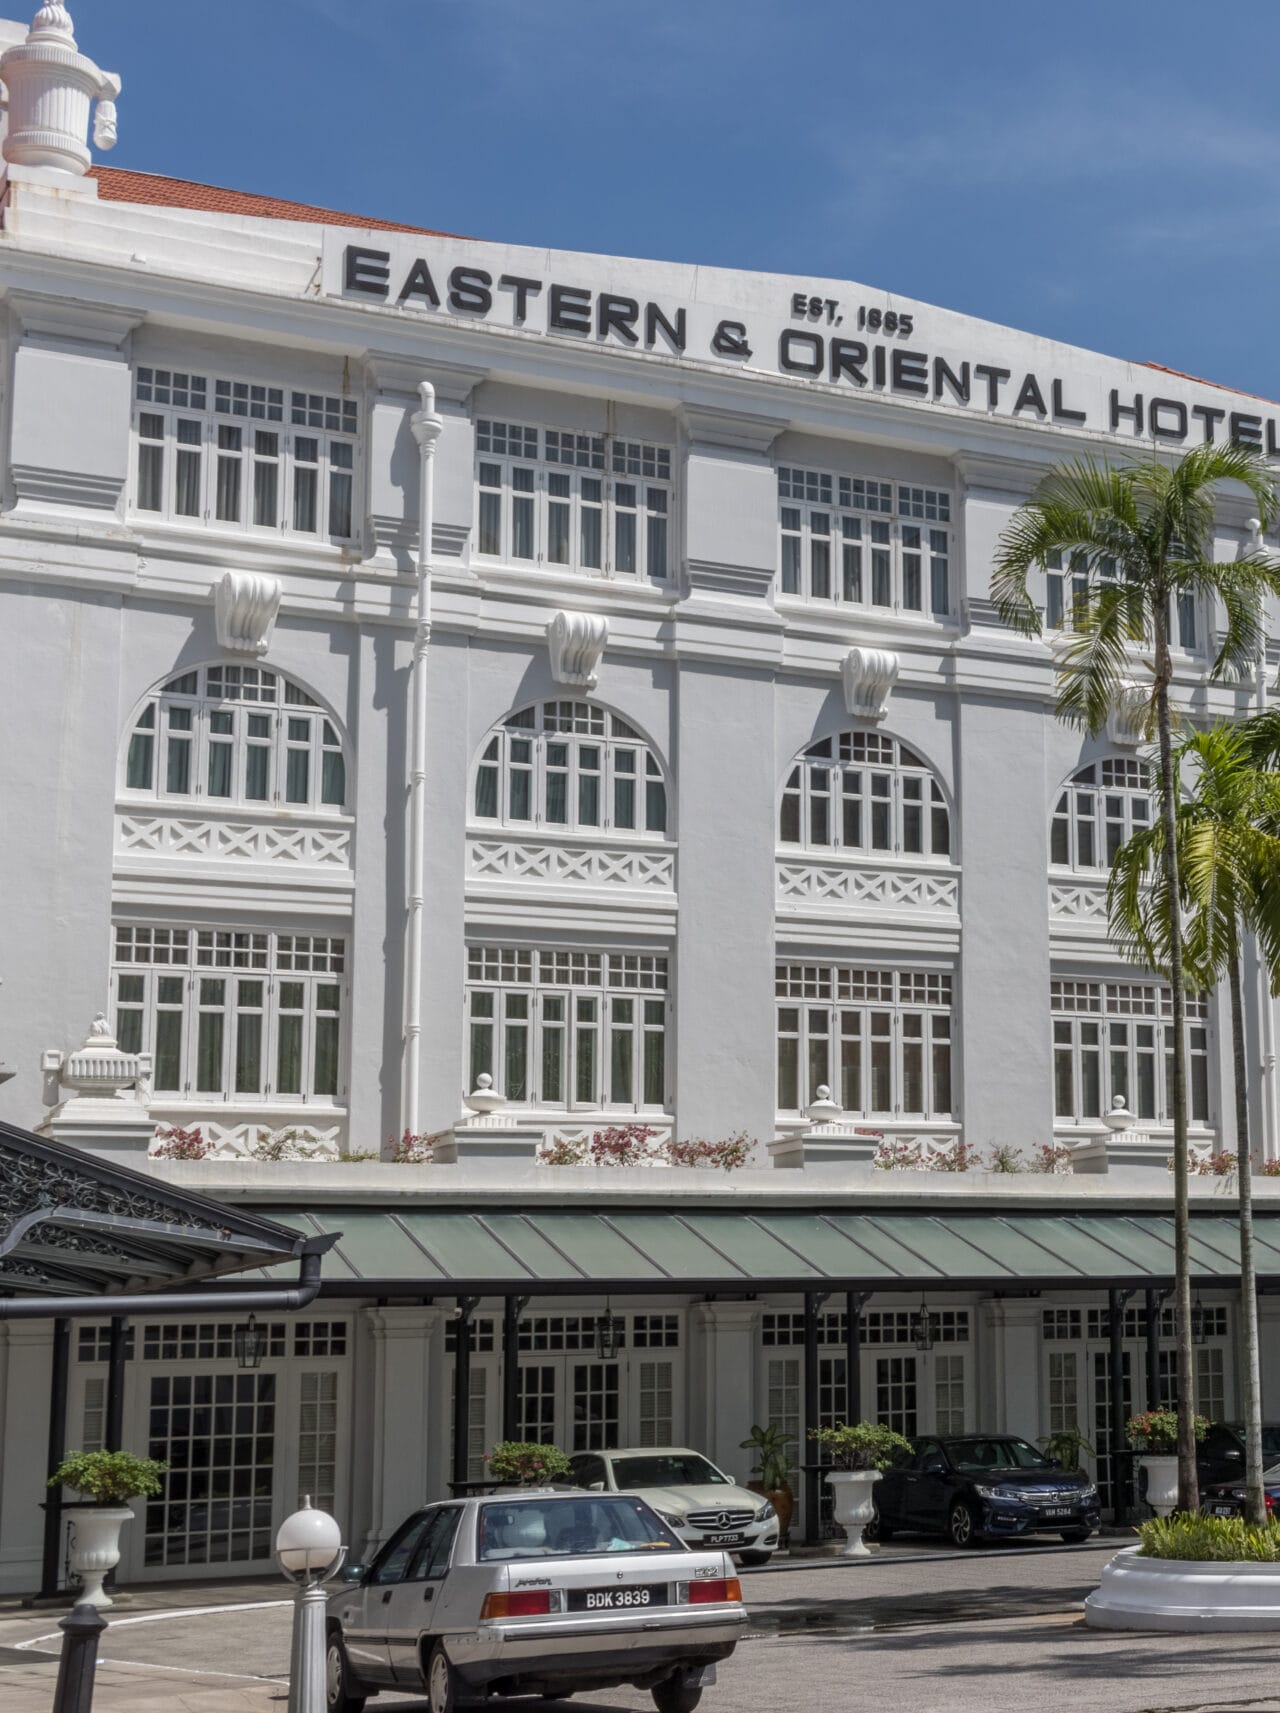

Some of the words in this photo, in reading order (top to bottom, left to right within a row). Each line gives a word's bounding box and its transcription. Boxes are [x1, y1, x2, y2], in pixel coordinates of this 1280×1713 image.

[344, 244, 687, 350] EASTERN
[712, 319, 753, 357] &
[780, 328, 1087, 421] ORIENTAL
[858, 305, 914, 335] 1885
[586, 1592, 614, 1608] BDK
[615, 1589, 651, 1607] 3839
